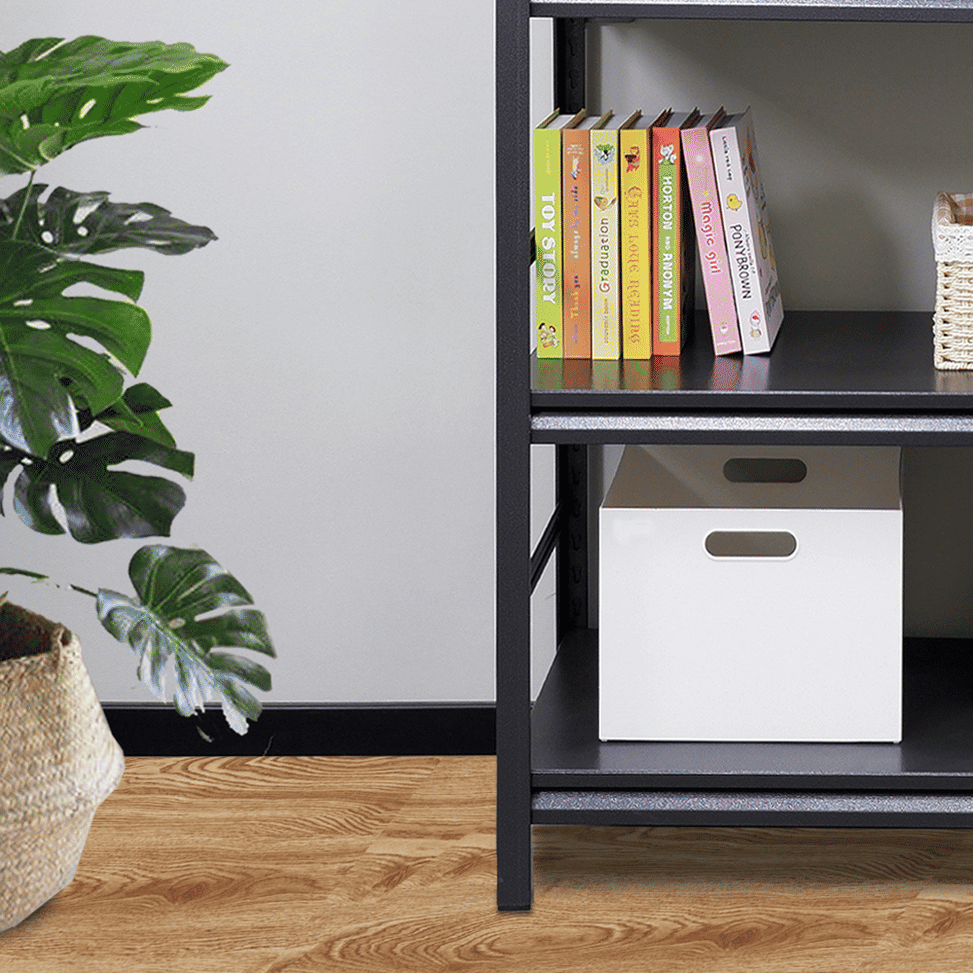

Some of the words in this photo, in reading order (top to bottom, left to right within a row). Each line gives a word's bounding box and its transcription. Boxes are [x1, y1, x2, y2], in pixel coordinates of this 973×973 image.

[541, 193, 555, 232] TOY
[662, 176, 673, 230] HORTON
[700, 202, 716, 246] Magic
[541, 237, 556, 304] STORY
[599, 218, 611, 292] Graduation
[662, 253, 673, 310] ANONYM
[704, 252, 721, 274] girl
[730, 224, 751, 299] PONYBROWN
[628, 280, 642, 344] READING
